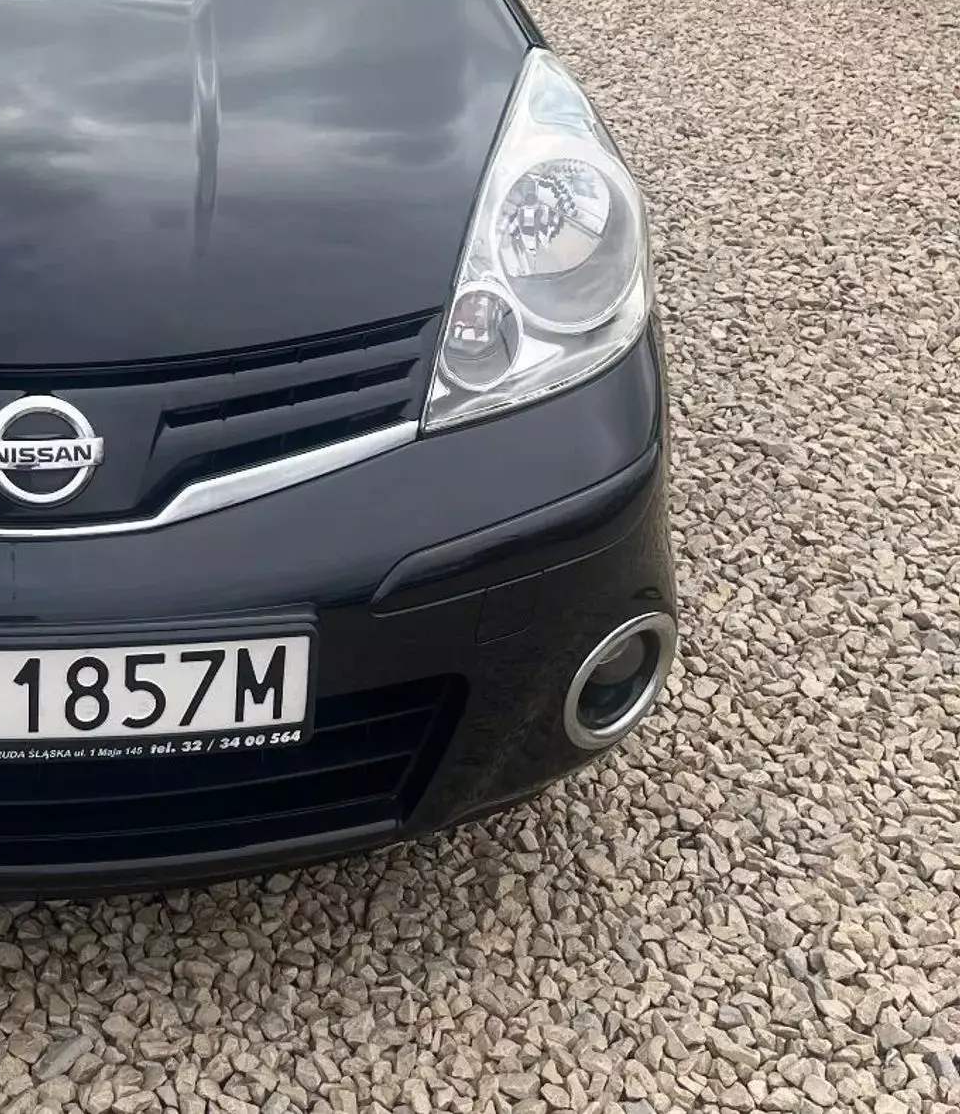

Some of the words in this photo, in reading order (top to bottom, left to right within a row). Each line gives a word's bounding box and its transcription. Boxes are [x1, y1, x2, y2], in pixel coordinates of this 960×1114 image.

[13, 645, 286, 734] 1857M
[74, 748, 87, 758] ul.
[150, 743, 176, 755] tel.
[181, 740, 202, 752] 32
[220, 737, 240, 750] 34
[245, 735, 265, 747] 00
[270, 730, 302, 745] 564
